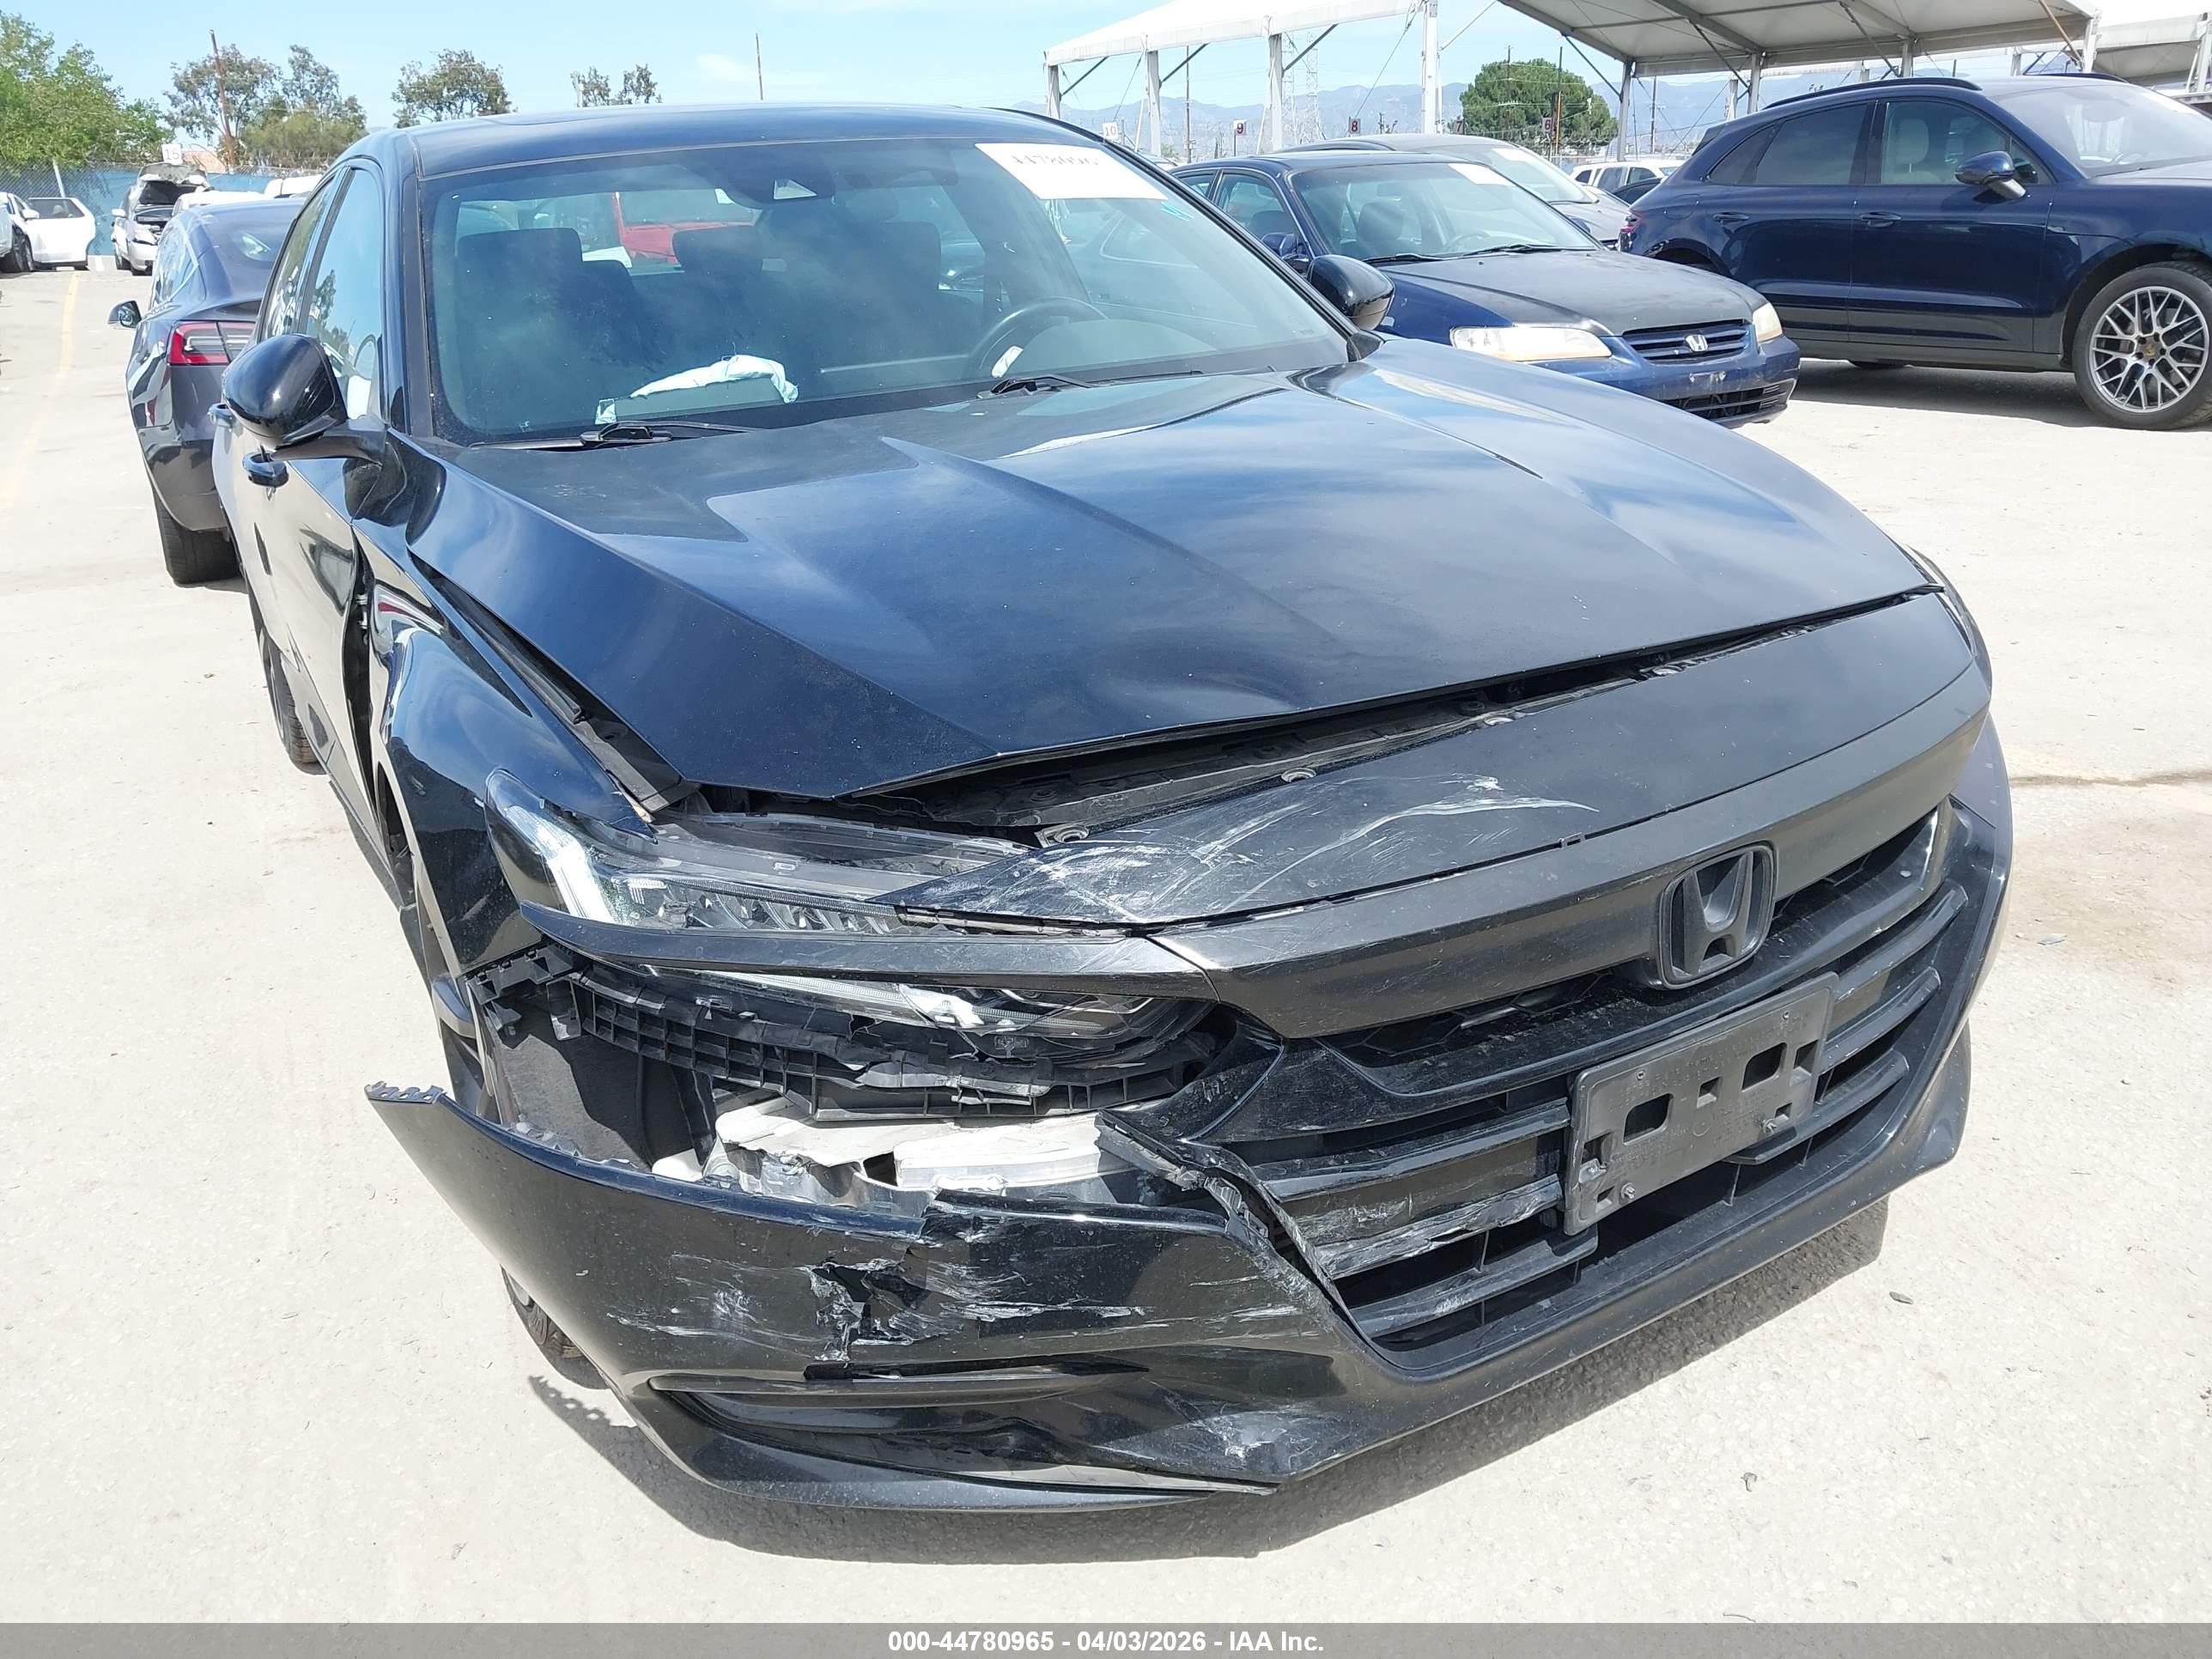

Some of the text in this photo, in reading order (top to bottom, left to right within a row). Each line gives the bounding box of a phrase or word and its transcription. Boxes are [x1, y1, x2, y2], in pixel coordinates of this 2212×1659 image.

[1105, 125, 1116, 137] 10
[1237, 122, 1243, 134] 9
[1351, 120, 1358, 132] 8
[1456, 120, 1462, 132] 7
[1545, 119, 1551, 131] 6
[165, 149, 179, 161] 15
